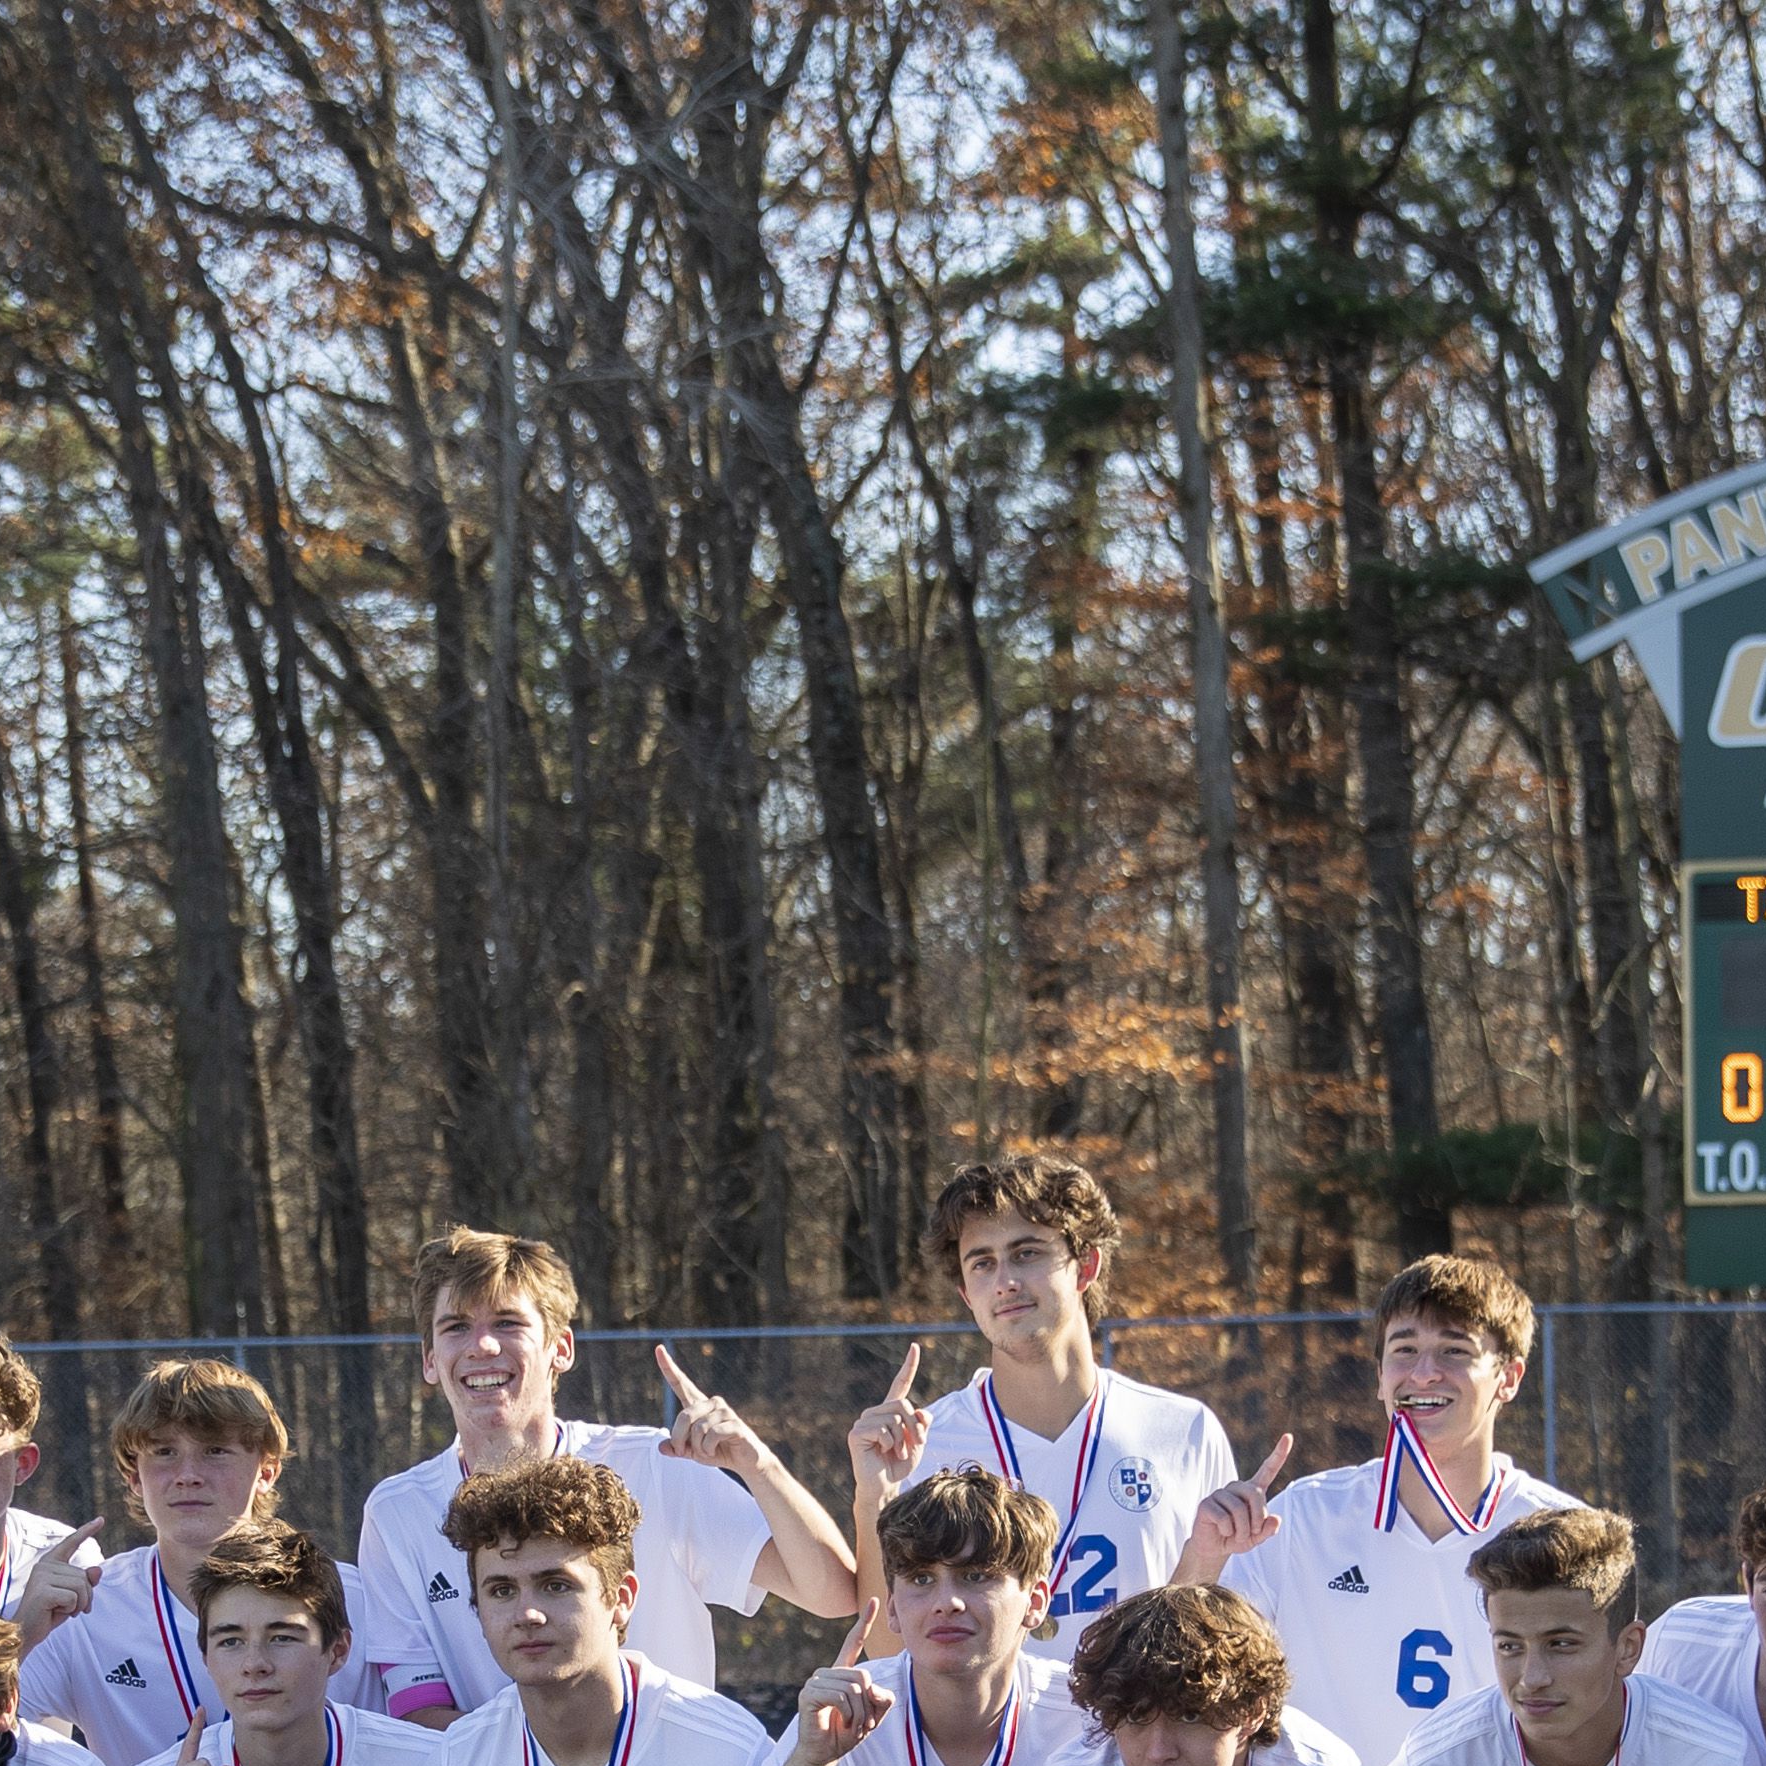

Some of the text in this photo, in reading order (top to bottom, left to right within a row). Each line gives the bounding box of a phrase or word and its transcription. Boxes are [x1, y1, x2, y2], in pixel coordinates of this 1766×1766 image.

[1719, 1050, 1765, 1125] 0
[1327, 1579, 1371, 1594] adidas
[105, 1672, 147, 1689] adidas
[1395, 1628, 1453, 1709] 6
